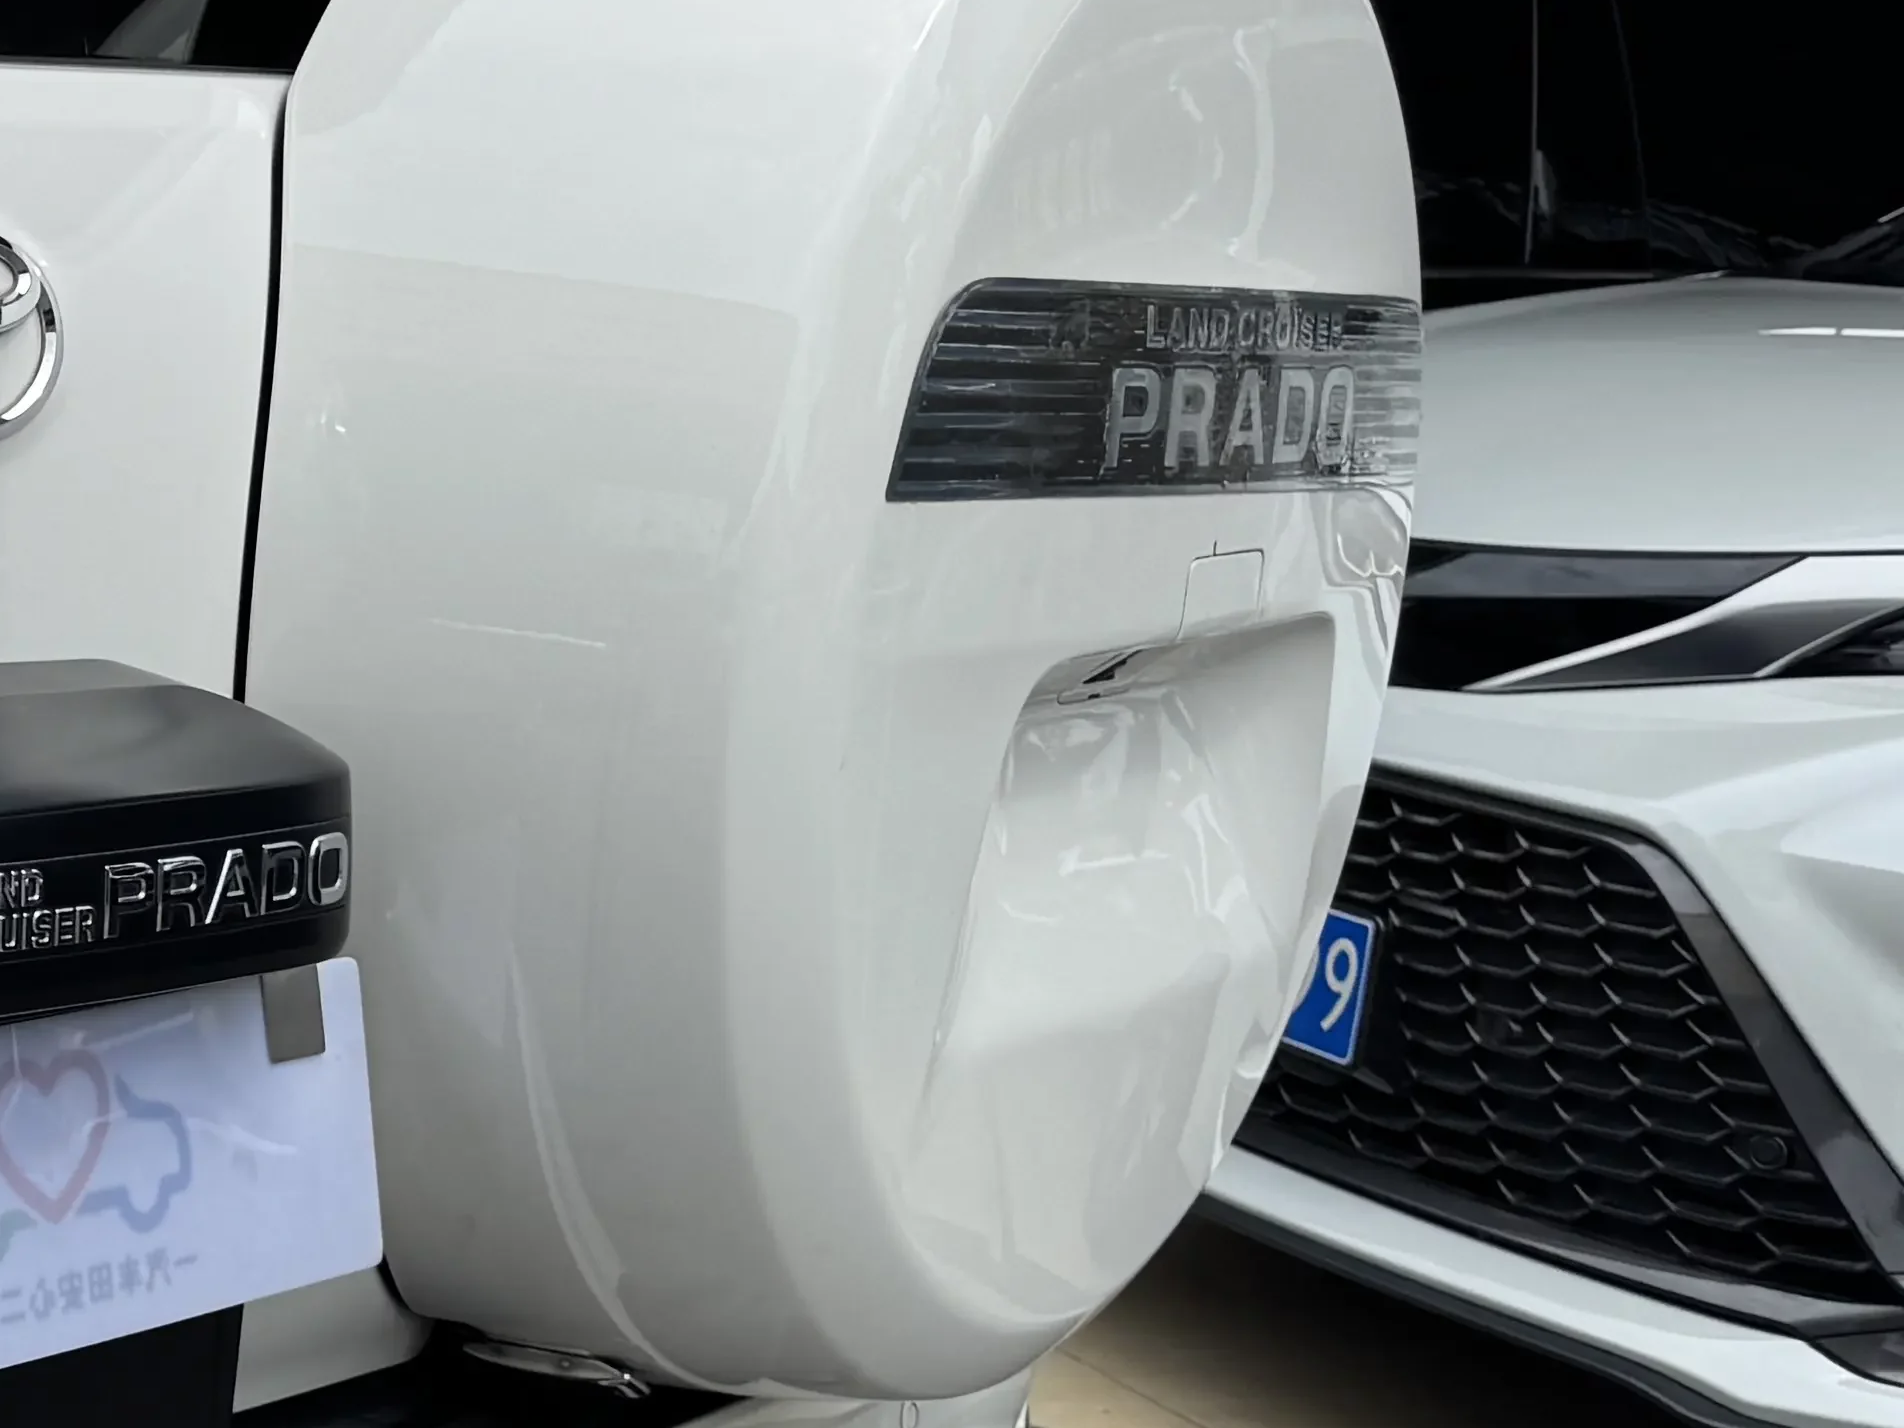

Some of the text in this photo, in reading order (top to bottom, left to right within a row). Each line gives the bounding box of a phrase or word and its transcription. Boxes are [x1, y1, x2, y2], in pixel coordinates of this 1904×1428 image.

[1144, 302, 1344, 352] LAND CRUISER
[1104, 363, 1356, 474] PRADO
[101, 830, 350, 939] PRADO
